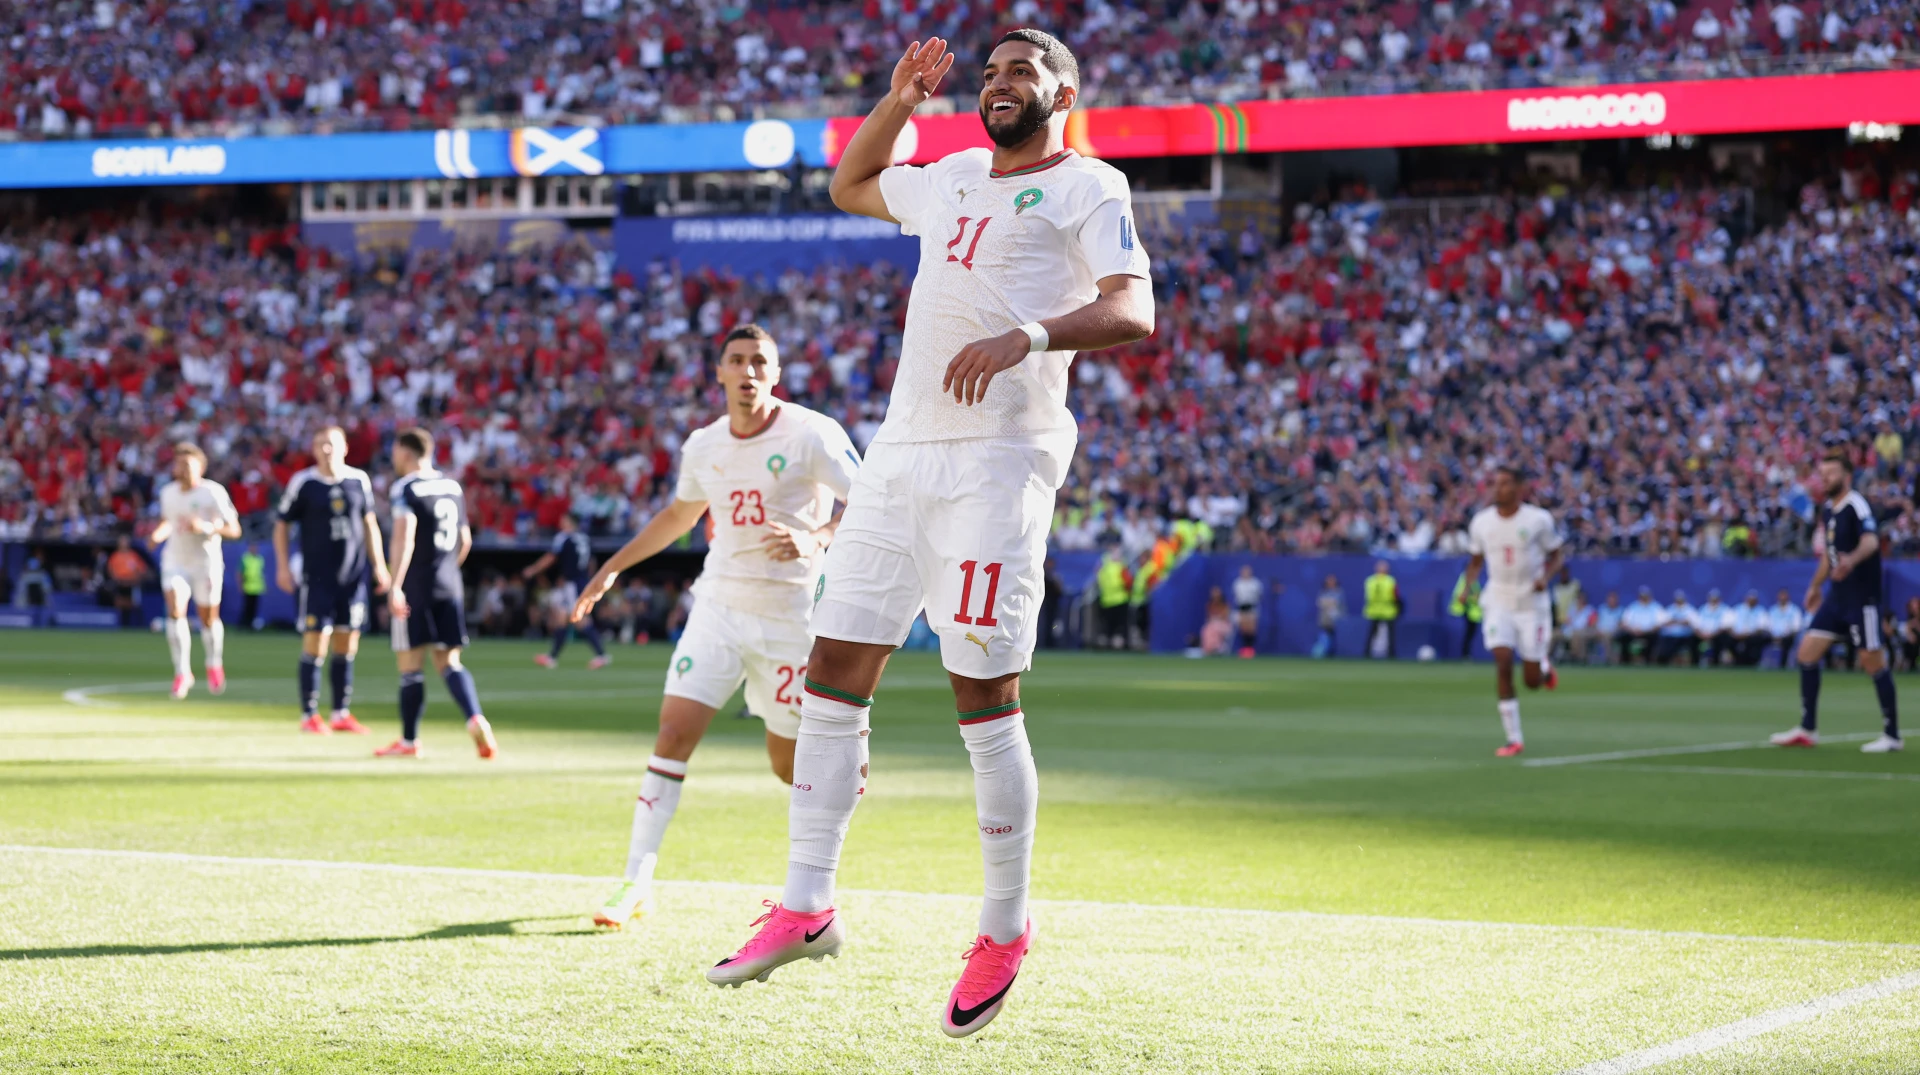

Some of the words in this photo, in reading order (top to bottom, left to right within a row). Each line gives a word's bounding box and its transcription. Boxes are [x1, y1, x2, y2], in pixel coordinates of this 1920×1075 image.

[1508, 91, 1666, 131] MOROCCO
[92, 145, 226, 177] SCOTLAND
[716, 218, 786, 242] WORLD
[788, 217, 827, 241] CUP
[946, 216, 992, 271] 11
[434, 498, 459, 551] 3
[730, 490, 765, 526] 23
[954, 560, 1003, 627] 11
